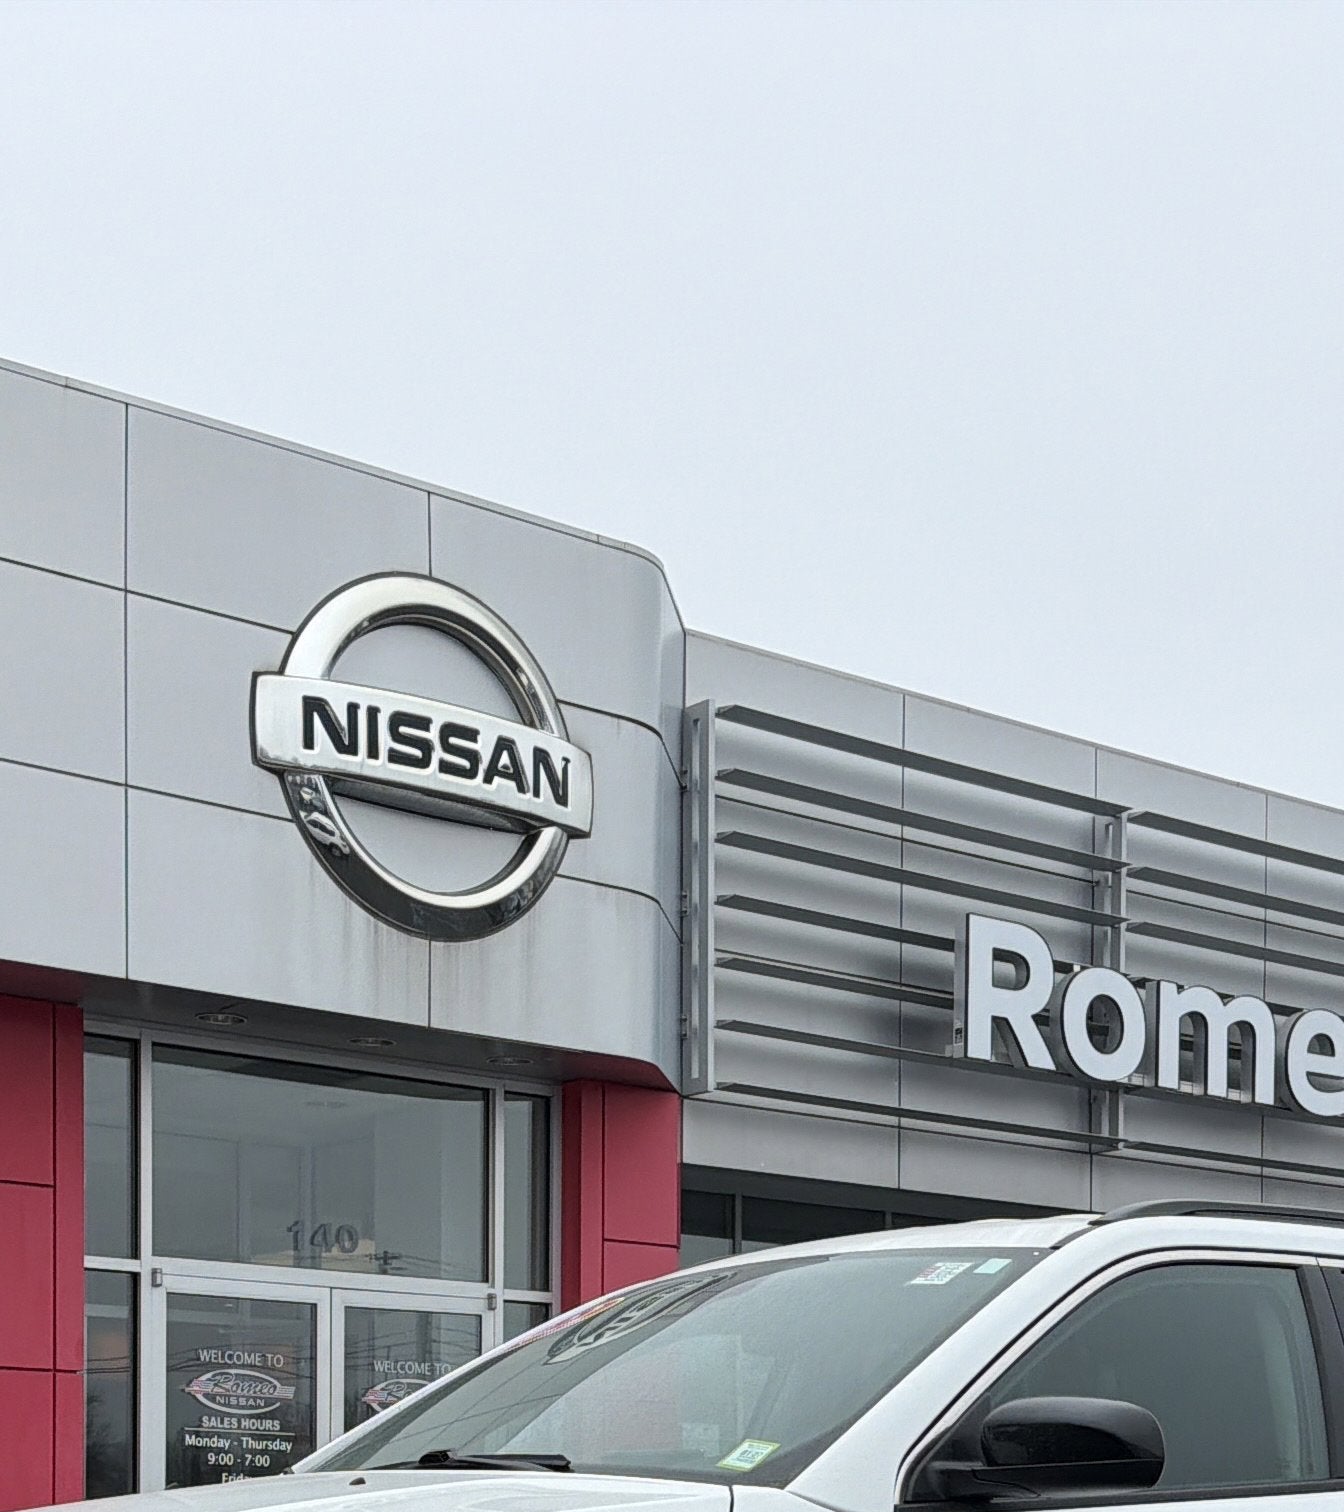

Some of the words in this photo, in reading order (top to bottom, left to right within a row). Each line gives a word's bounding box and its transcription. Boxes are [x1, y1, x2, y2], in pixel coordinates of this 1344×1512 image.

[301, 694, 572, 809] NISSAN
[287, 1220, 359, 1254] 140
[198, 1349, 264, 1365] WELCOME
[266, 1354, 284, 1368] TO
[374, 1360, 431, 1375] WELCOME
[433, 1363, 452, 1375] TO
[210, 1373, 278, 1396] Romeo
[215, 1395, 265, 1407] NISSAN
[201, 1415, 238, 1429] SALES
[241, 1417, 281, 1431] HOURS
[184, 1433, 231, 1449] Monday
[241, 1436, 293, 1453] Thursday
[207, 1452, 234, 1465] 9:00
[244, 1454, 271, 1467] 7:00
